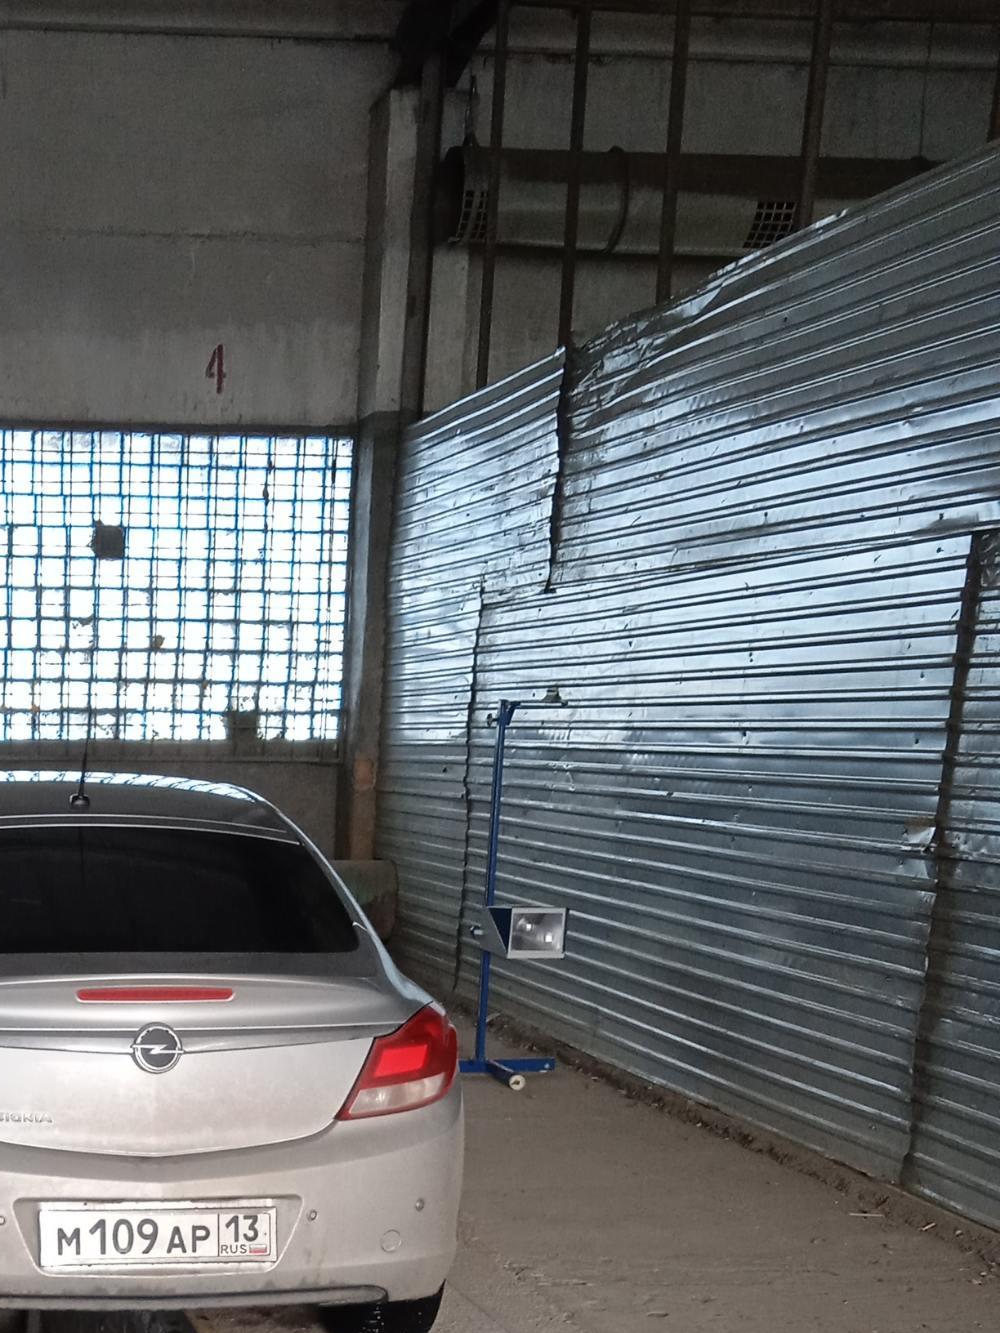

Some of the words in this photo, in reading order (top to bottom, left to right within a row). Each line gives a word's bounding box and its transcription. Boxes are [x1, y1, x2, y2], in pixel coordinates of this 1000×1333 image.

[205, 343, 226, 394] 4
[225, 1215, 259, 1242] 13
[220, 1244, 247, 1255] RUS
